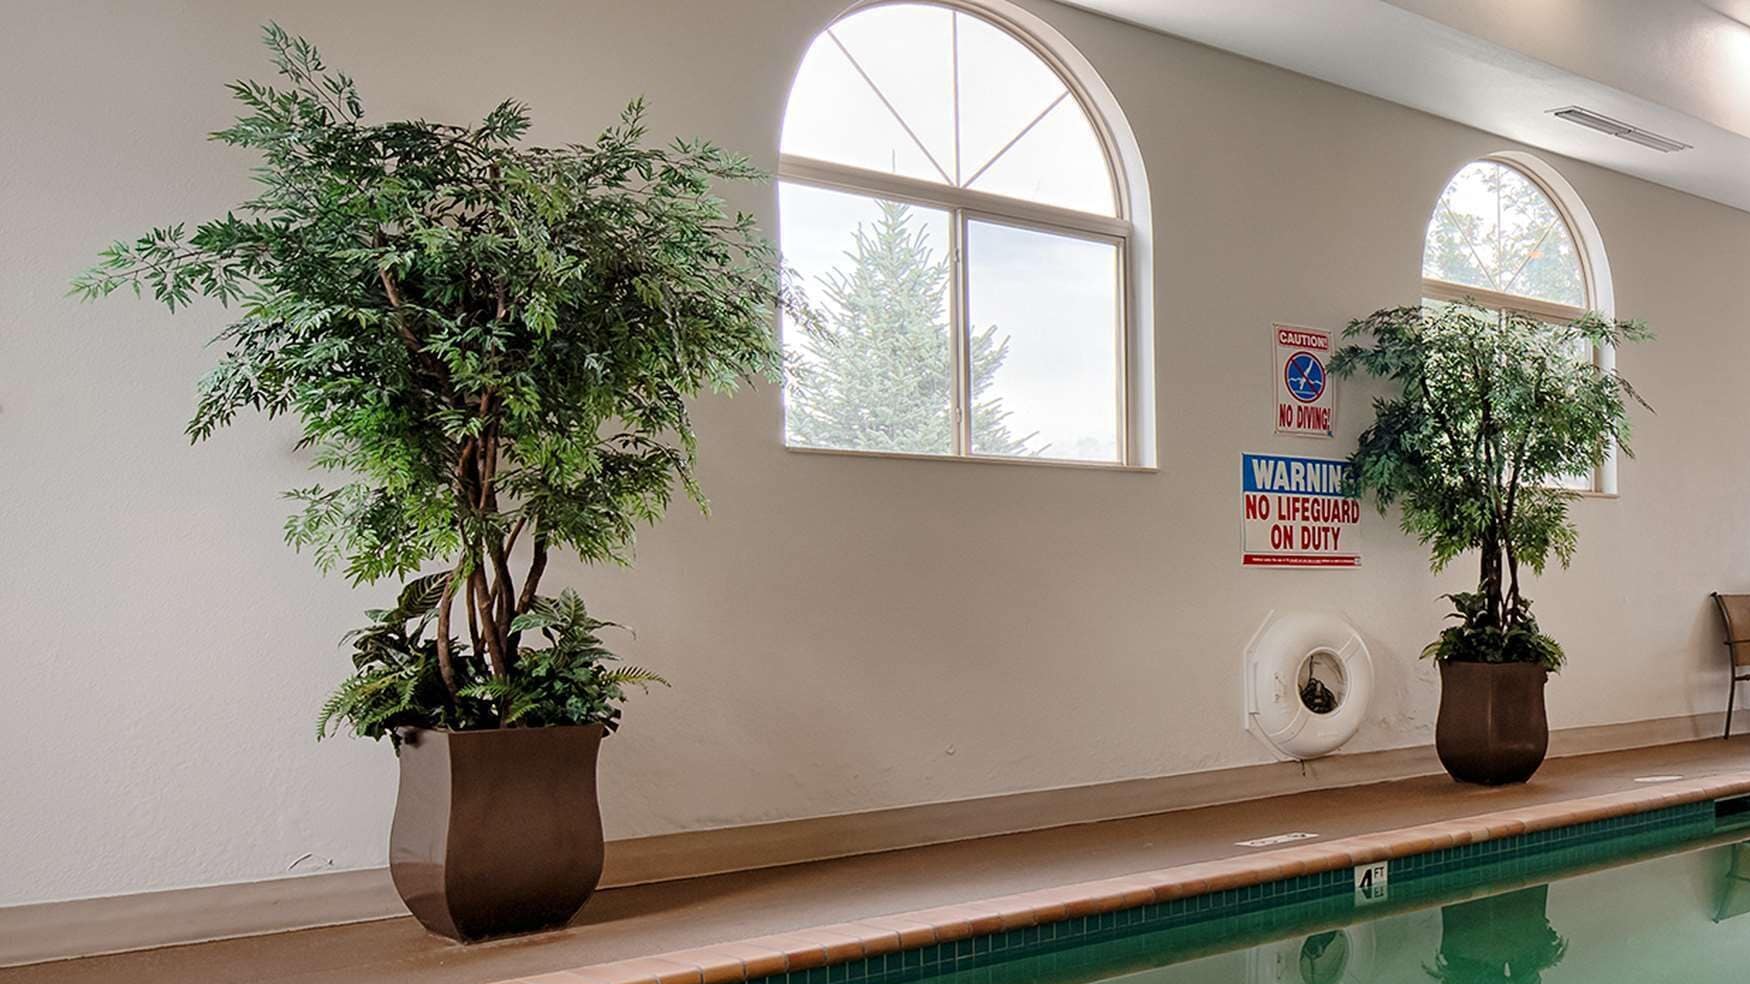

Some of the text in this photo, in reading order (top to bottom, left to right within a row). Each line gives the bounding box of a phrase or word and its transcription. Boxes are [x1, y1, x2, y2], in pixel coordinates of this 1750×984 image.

[1279, 331, 1328, 348] CAUTION!
[1279, 403, 1331, 430] NO DIVING!
[1245, 494, 1361, 523] NO LIFEGUARD
[1270, 524, 1341, 551] ON DUTY
[1374, 867, 1385, 879] FT
